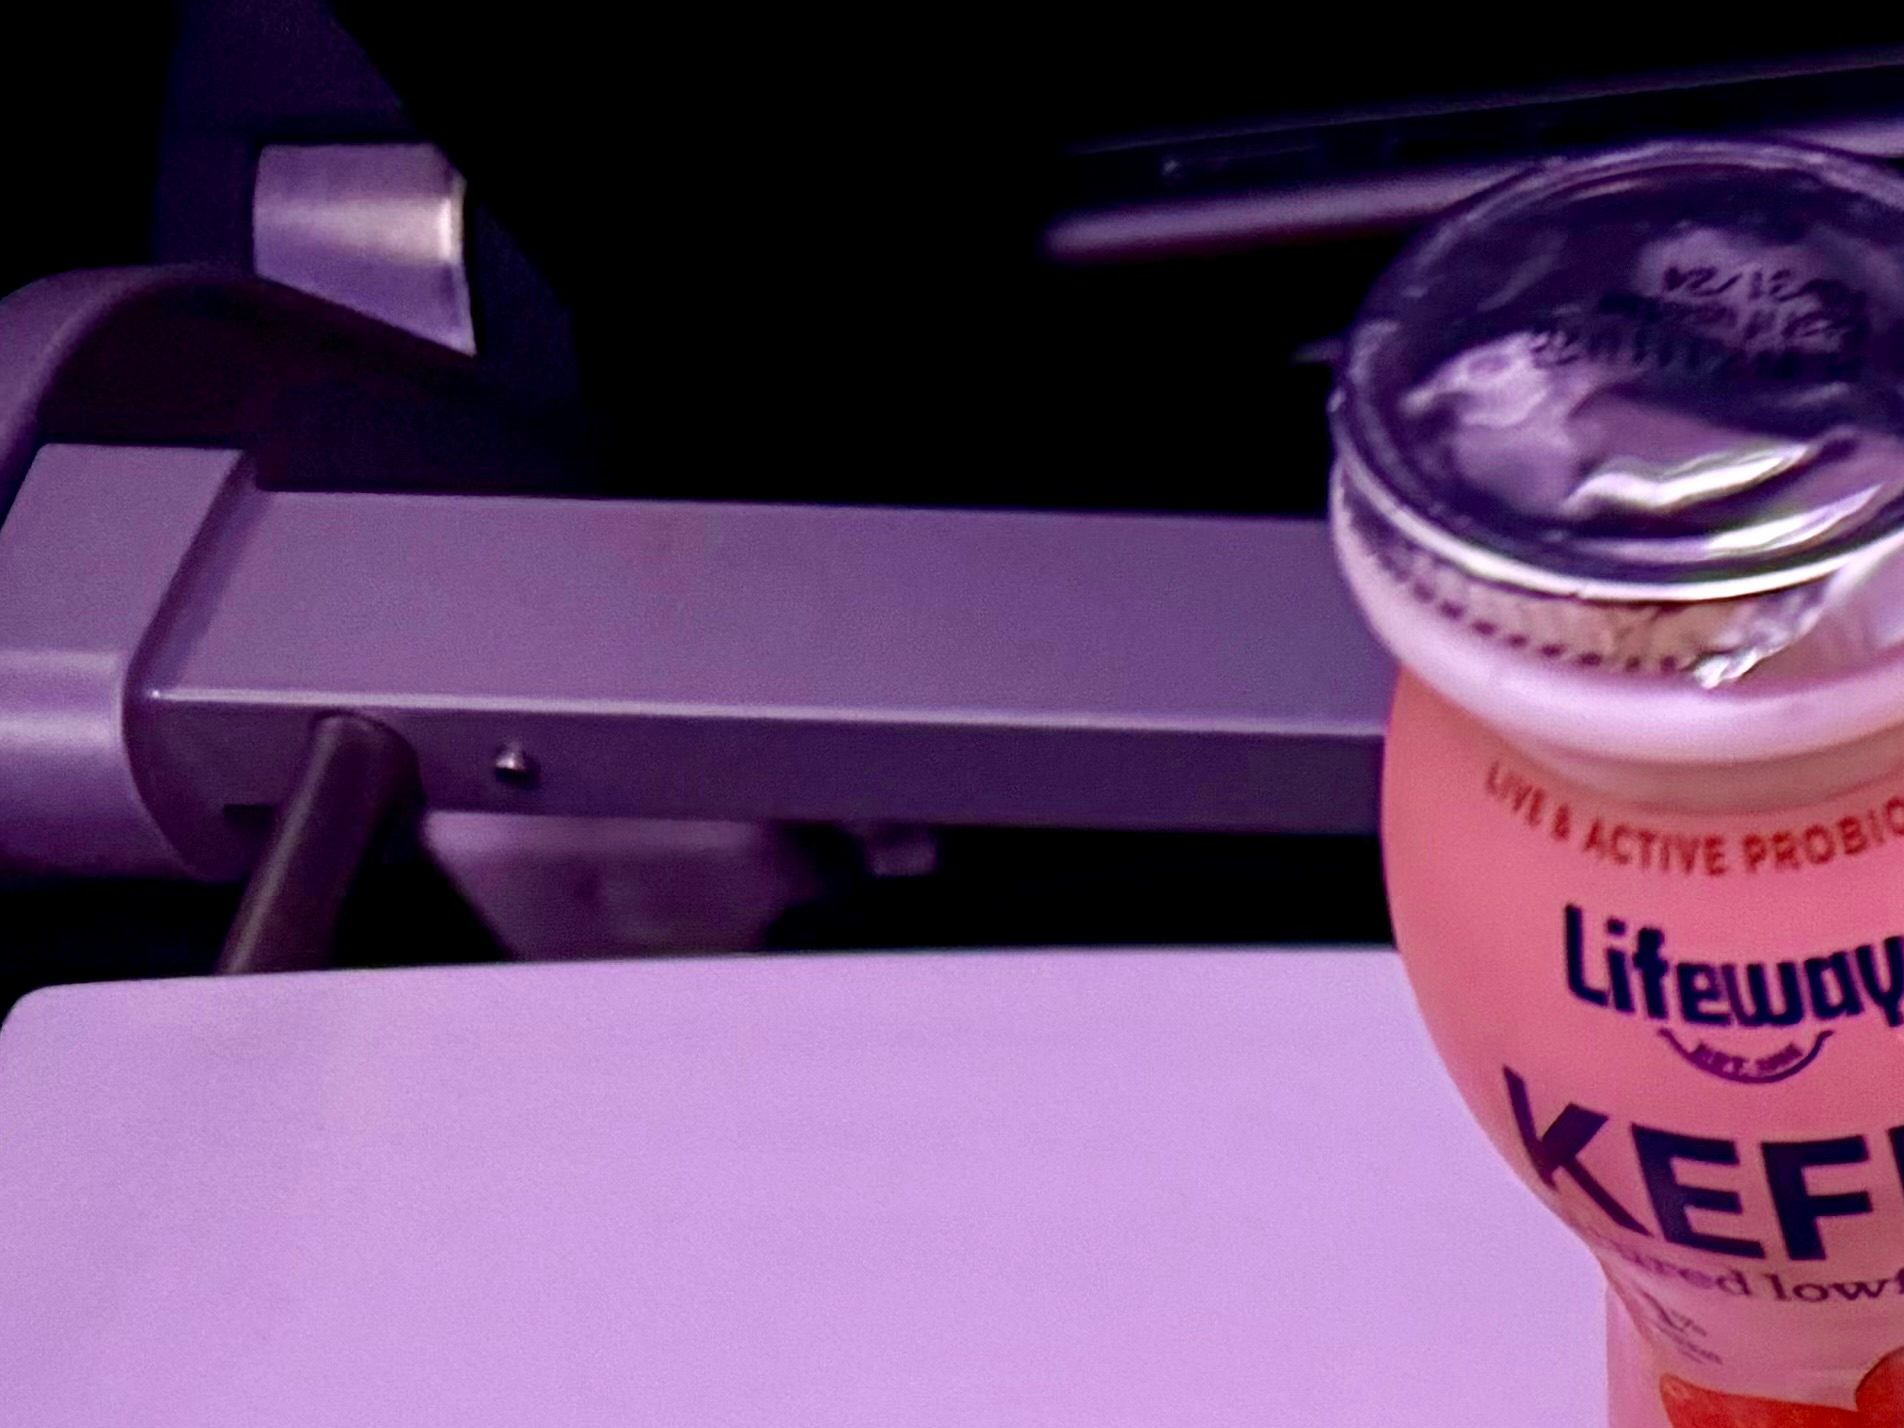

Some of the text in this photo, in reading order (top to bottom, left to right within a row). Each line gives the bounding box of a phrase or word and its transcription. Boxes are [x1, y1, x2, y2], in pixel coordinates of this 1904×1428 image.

[1485, 759, 1545, 833] LIVE
[1550, 809, 1574, 844] &
[1584, 819, 1728, 878] ACTIVE
